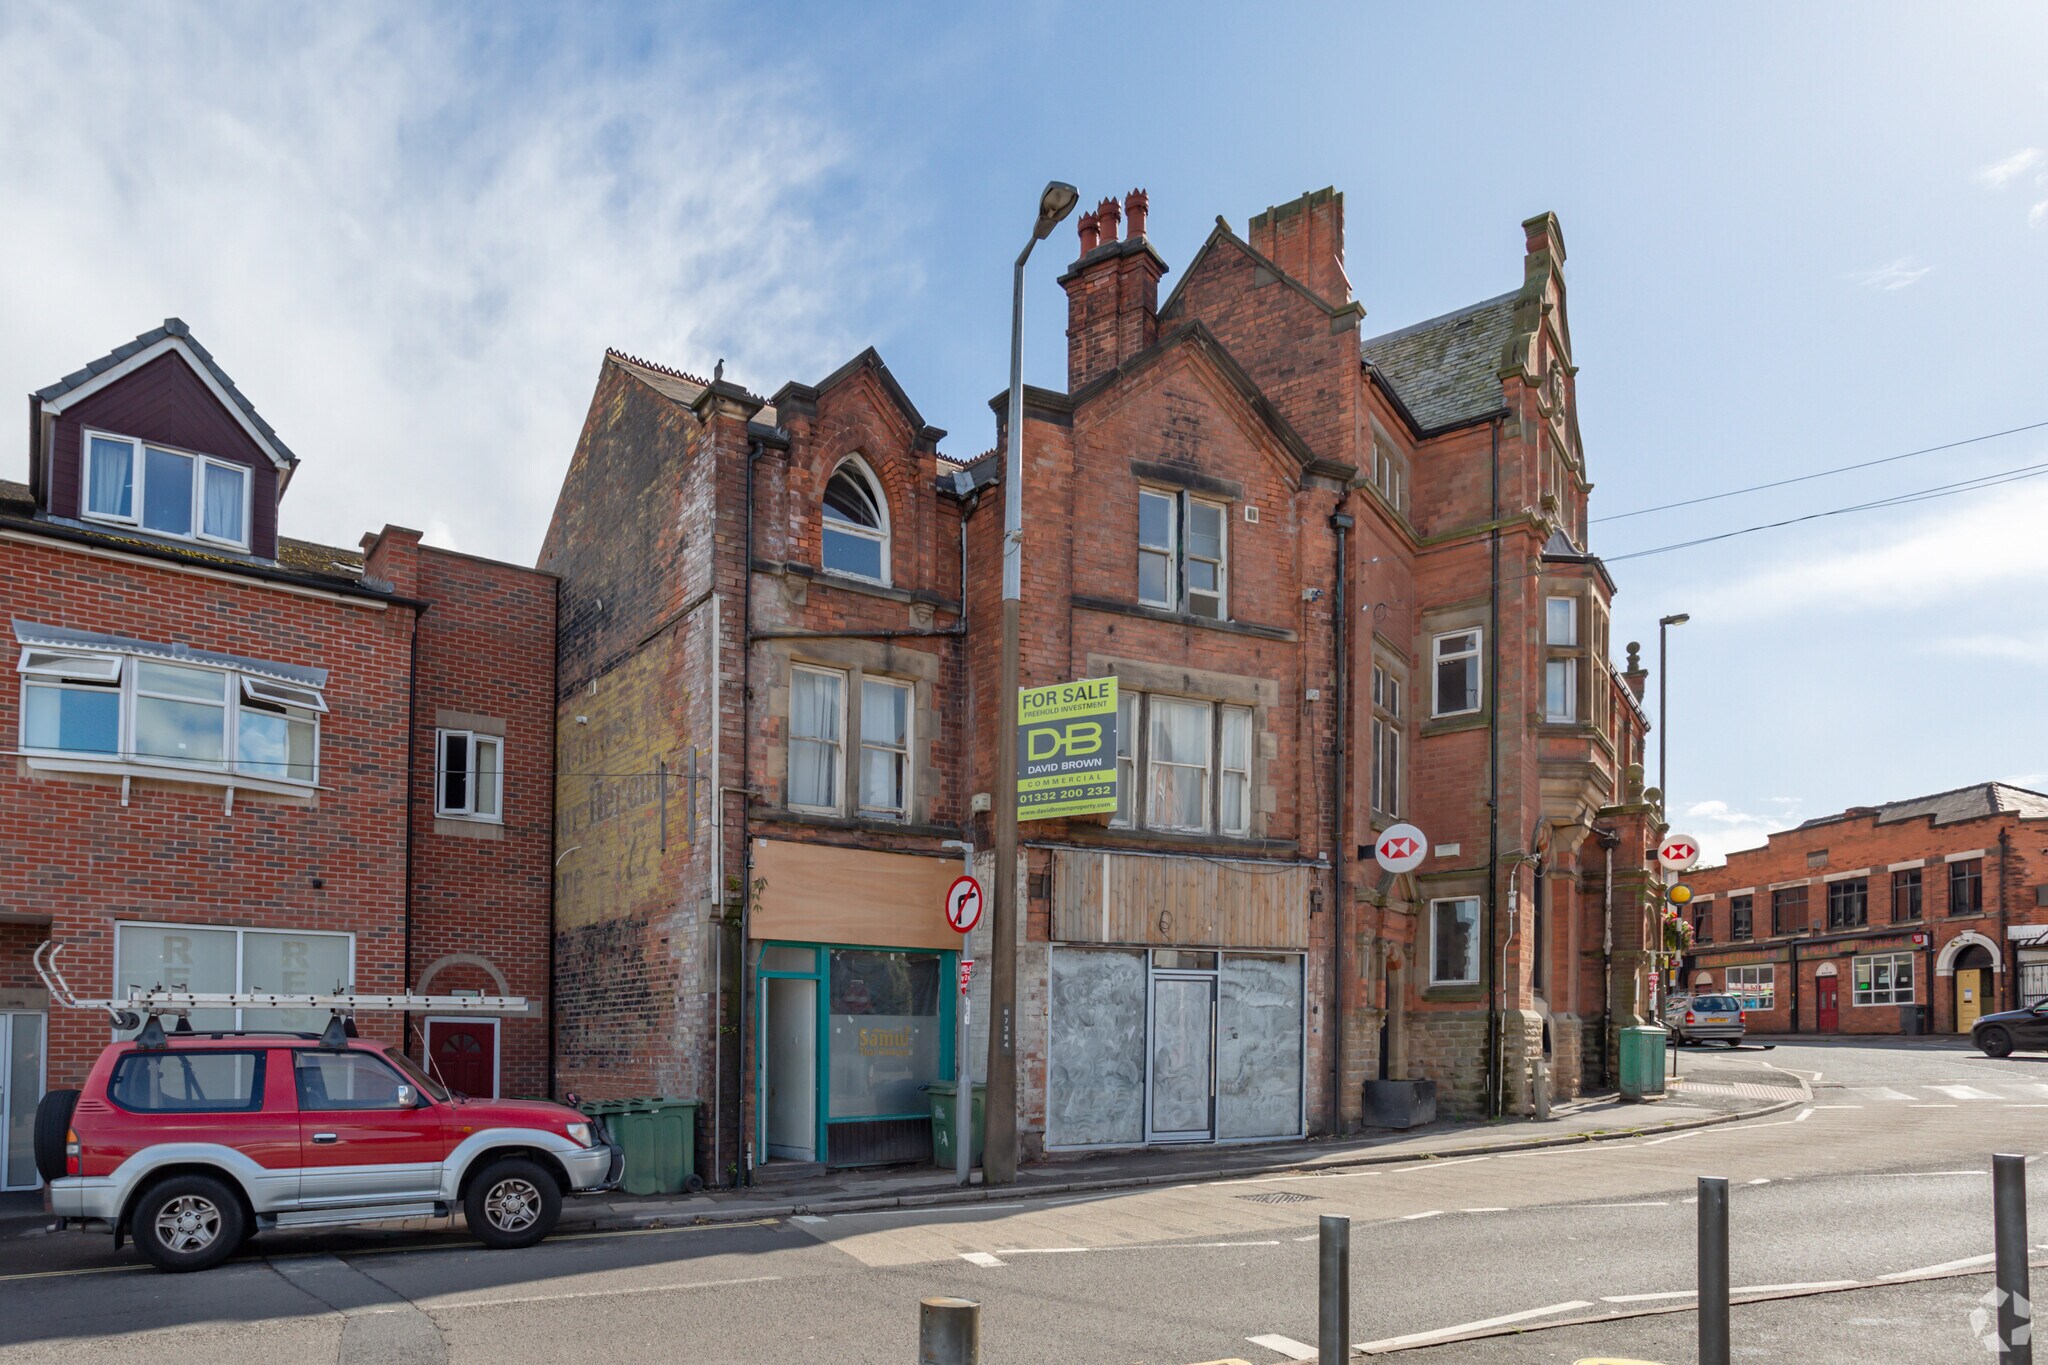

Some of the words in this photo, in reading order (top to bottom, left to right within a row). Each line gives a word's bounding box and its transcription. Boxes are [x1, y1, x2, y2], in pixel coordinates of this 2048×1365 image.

[1022, 691, 1057, 710] FOR
[1062, 683, 1109, 703] SALE
[1024, 707, 1059, 718] FREEHOLD
[1060, 700, 1108, 713] INVESTMENT
[1027, 721, 1102, 762] DB
[1028, 763, 1059, 775] DAVID
[1061, 758, 1102, 771] BROWN
[1027, 774, 1102, 788] COMMERCIAL
[1019, 791, 1056, 804] 01332
[1060, 789, 1083, 799] 200
[1086, 786, 1111, 796] 232
[1020, 802, 1111, 817] www.davidbrownproperty.com
[860, 1025, 912, 1047] Samui
